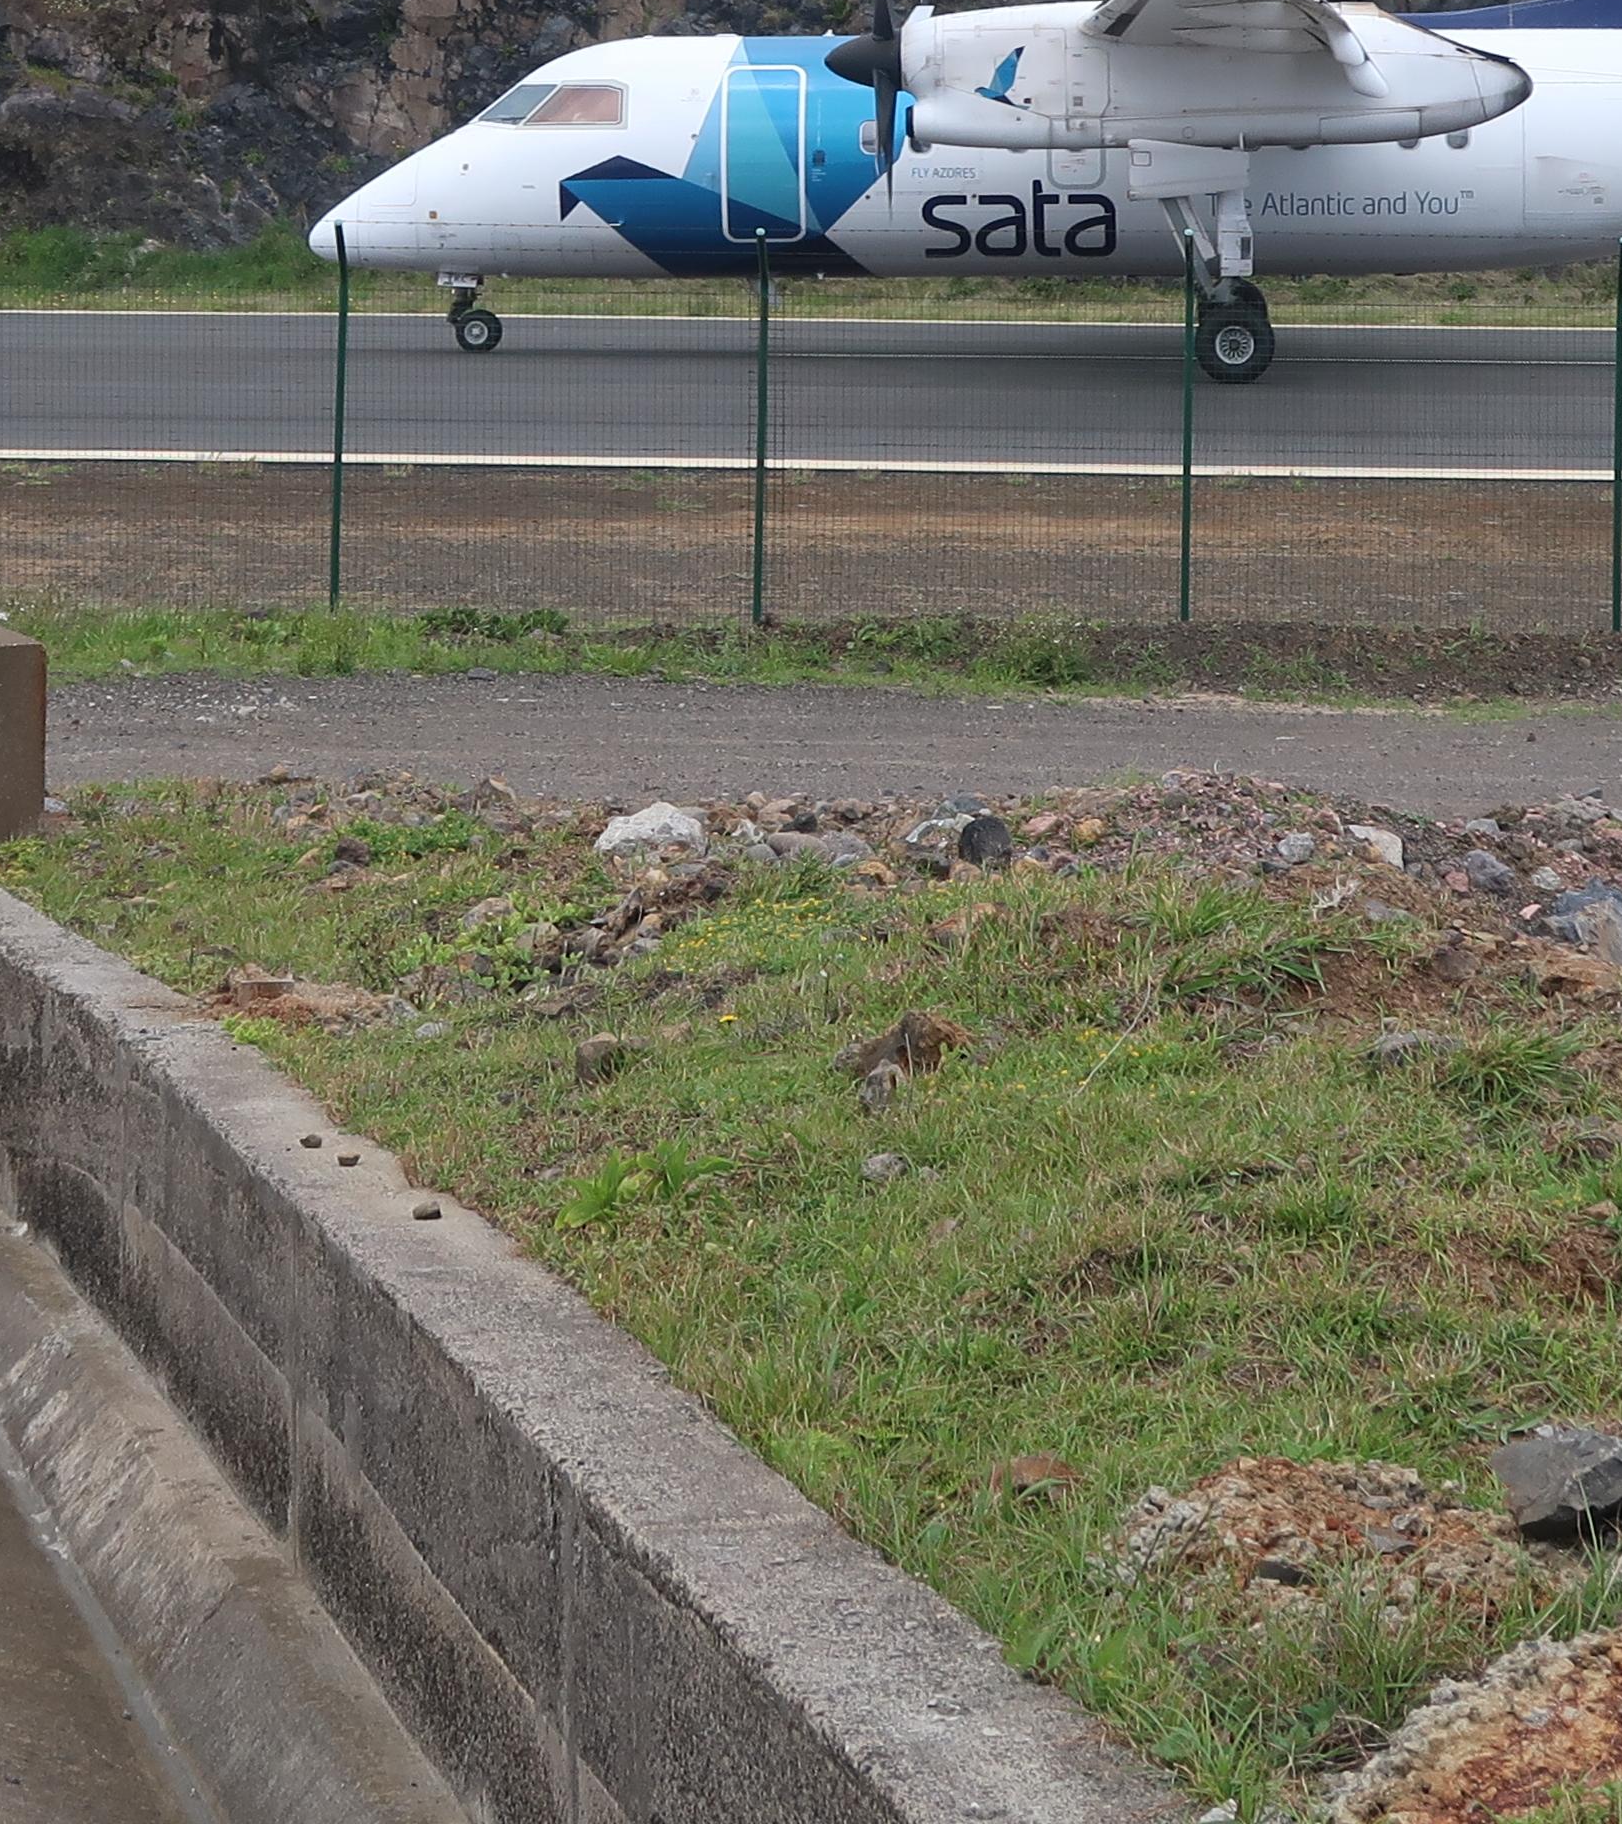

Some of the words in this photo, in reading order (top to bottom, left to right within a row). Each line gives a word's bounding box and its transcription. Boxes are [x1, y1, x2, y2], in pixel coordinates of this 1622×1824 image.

[911, 167, 930, 179] FLY
[932, 167, 976, 179] AZORES
[1204, 192, 1252, 217] Te
[1260, 191, 1355, 217] Atlantic
[1362, 191, 1407, 216] and
[921, 179, 1117, 258] sata
